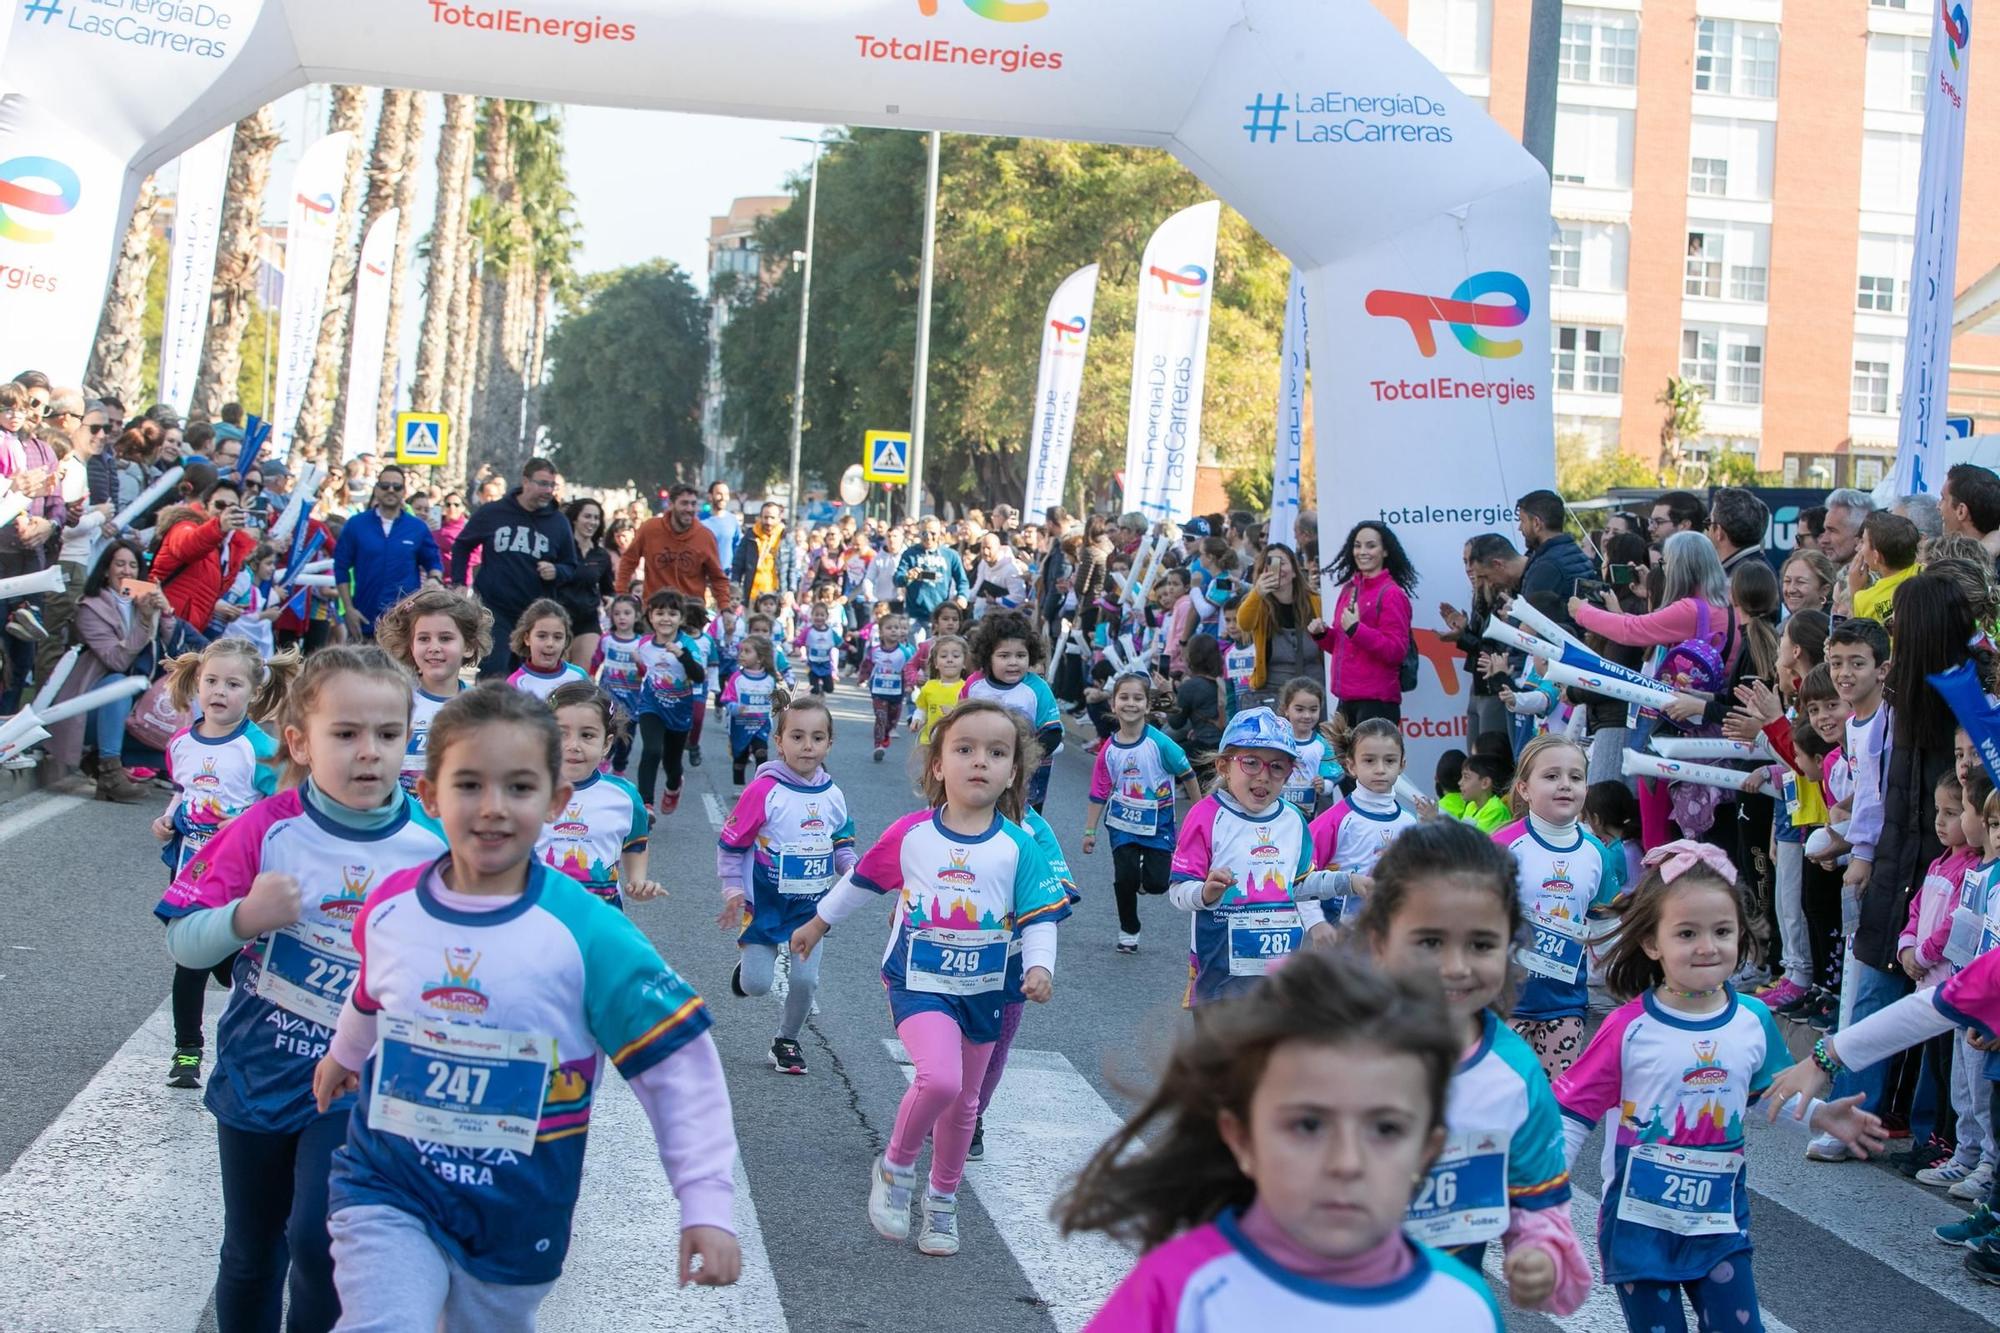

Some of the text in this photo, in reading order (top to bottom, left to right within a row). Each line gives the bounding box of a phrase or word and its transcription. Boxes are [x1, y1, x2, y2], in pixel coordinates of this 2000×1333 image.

[67, 6, 228, 58] LasCarreras
[428, 0, 636, 44] TotalEnergies
[855, 34, 1063, 73] TotalEnergies
[1295, 118, 1453, 143] LasCarreras
[1370, 377, 1536, 405] TotalEnergies
[1160, 356, 1193, 492] LasCarreras
[494, 525, 550, 559] GAP
[1599, 659, 1675, 694] AVANZA FIBRA
[1284, 790, 1305, 803] 660
[1121, 807, 1143, 822] 243
[803, 859, 828, 876] 254
[1259, 933, 1292, 954] 282
[1535, 931, 1567, 957] 234
[940, 949, 980, 972] 249
[266, 1010, 333, 1040] AVAN
[275, 1033, 328, 1059] FIBR
[425, 1061, 491, 1106] 247
[405, 1137, 519, 1166] VANZA
[1661, 1174, 1712, 1208] 250
